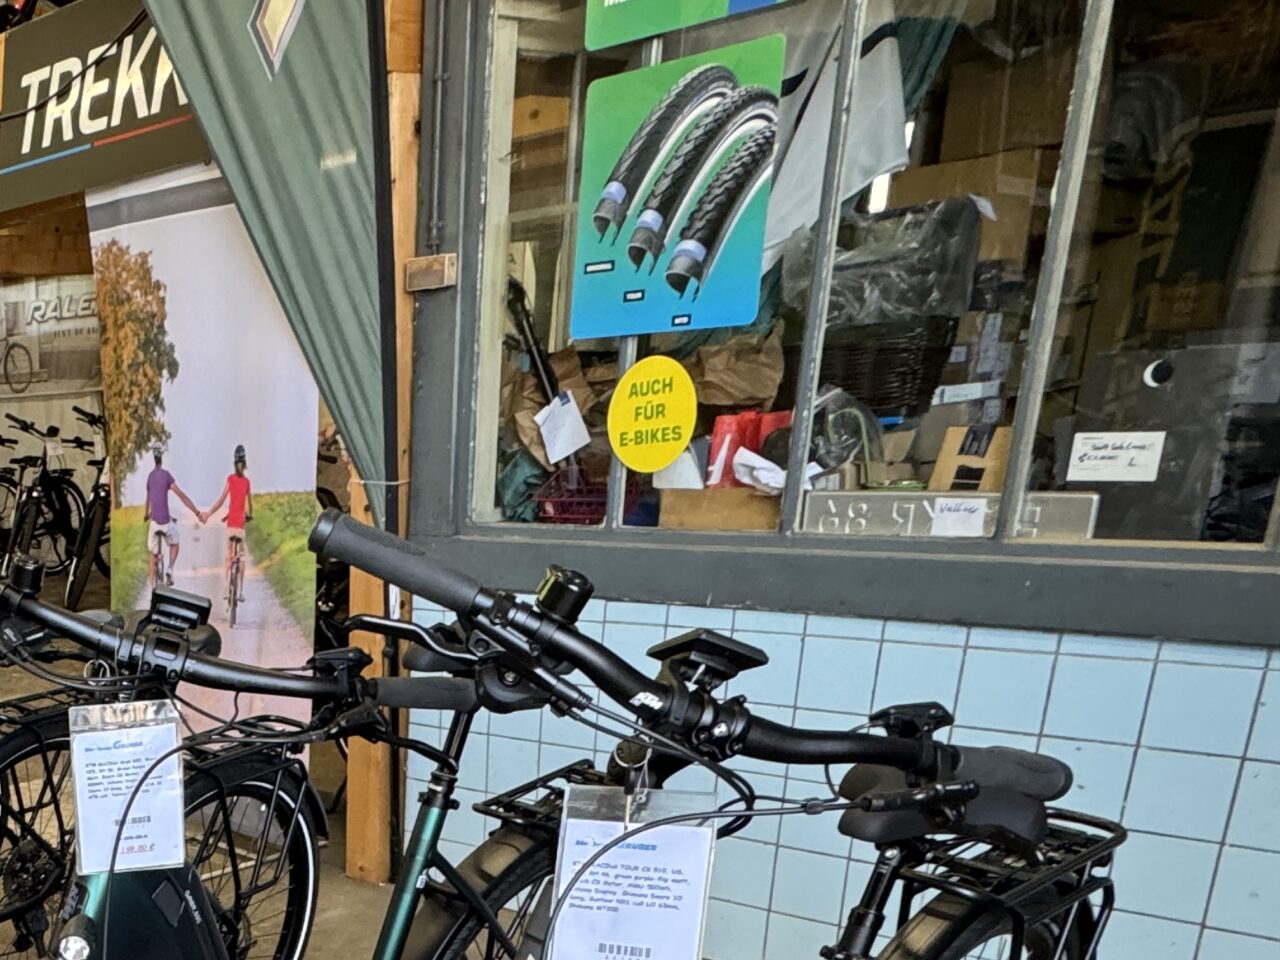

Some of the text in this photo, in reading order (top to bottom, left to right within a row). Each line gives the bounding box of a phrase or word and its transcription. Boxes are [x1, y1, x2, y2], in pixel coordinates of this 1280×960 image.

[628, 377, 674, 398] AUCH
[634, 400, 666, 422] FÜR
[619, 425, 683, 447] E-BIKES
